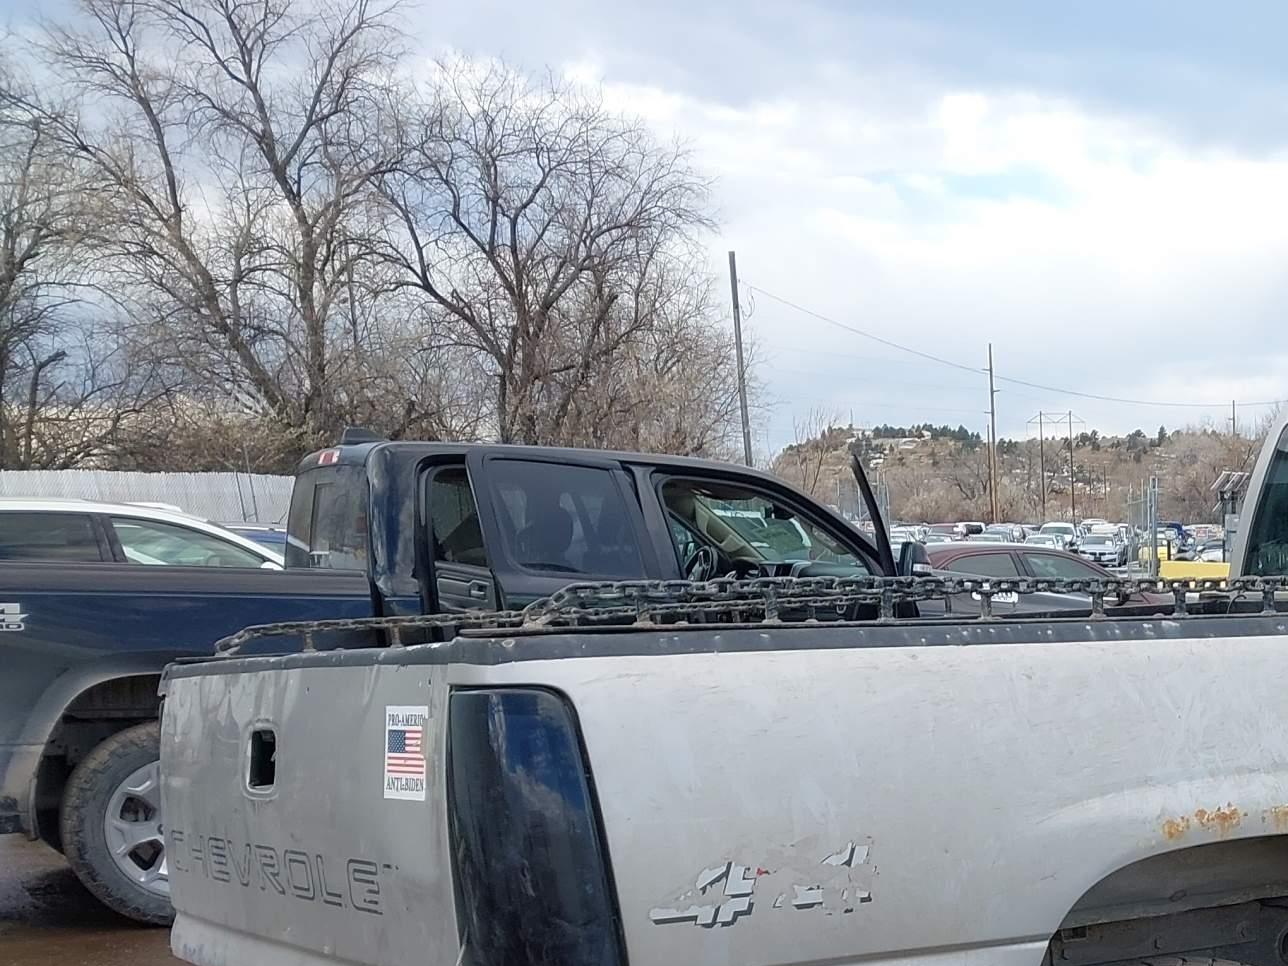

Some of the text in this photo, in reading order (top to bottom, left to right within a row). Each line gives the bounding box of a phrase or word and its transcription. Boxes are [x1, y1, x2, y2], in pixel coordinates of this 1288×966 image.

[388, 713, 425, 726] PRO-AMERIC
[386, 777, 424, 792] ANTI-BIDEN
[171, 829, 399, 915] CHEVROLE
